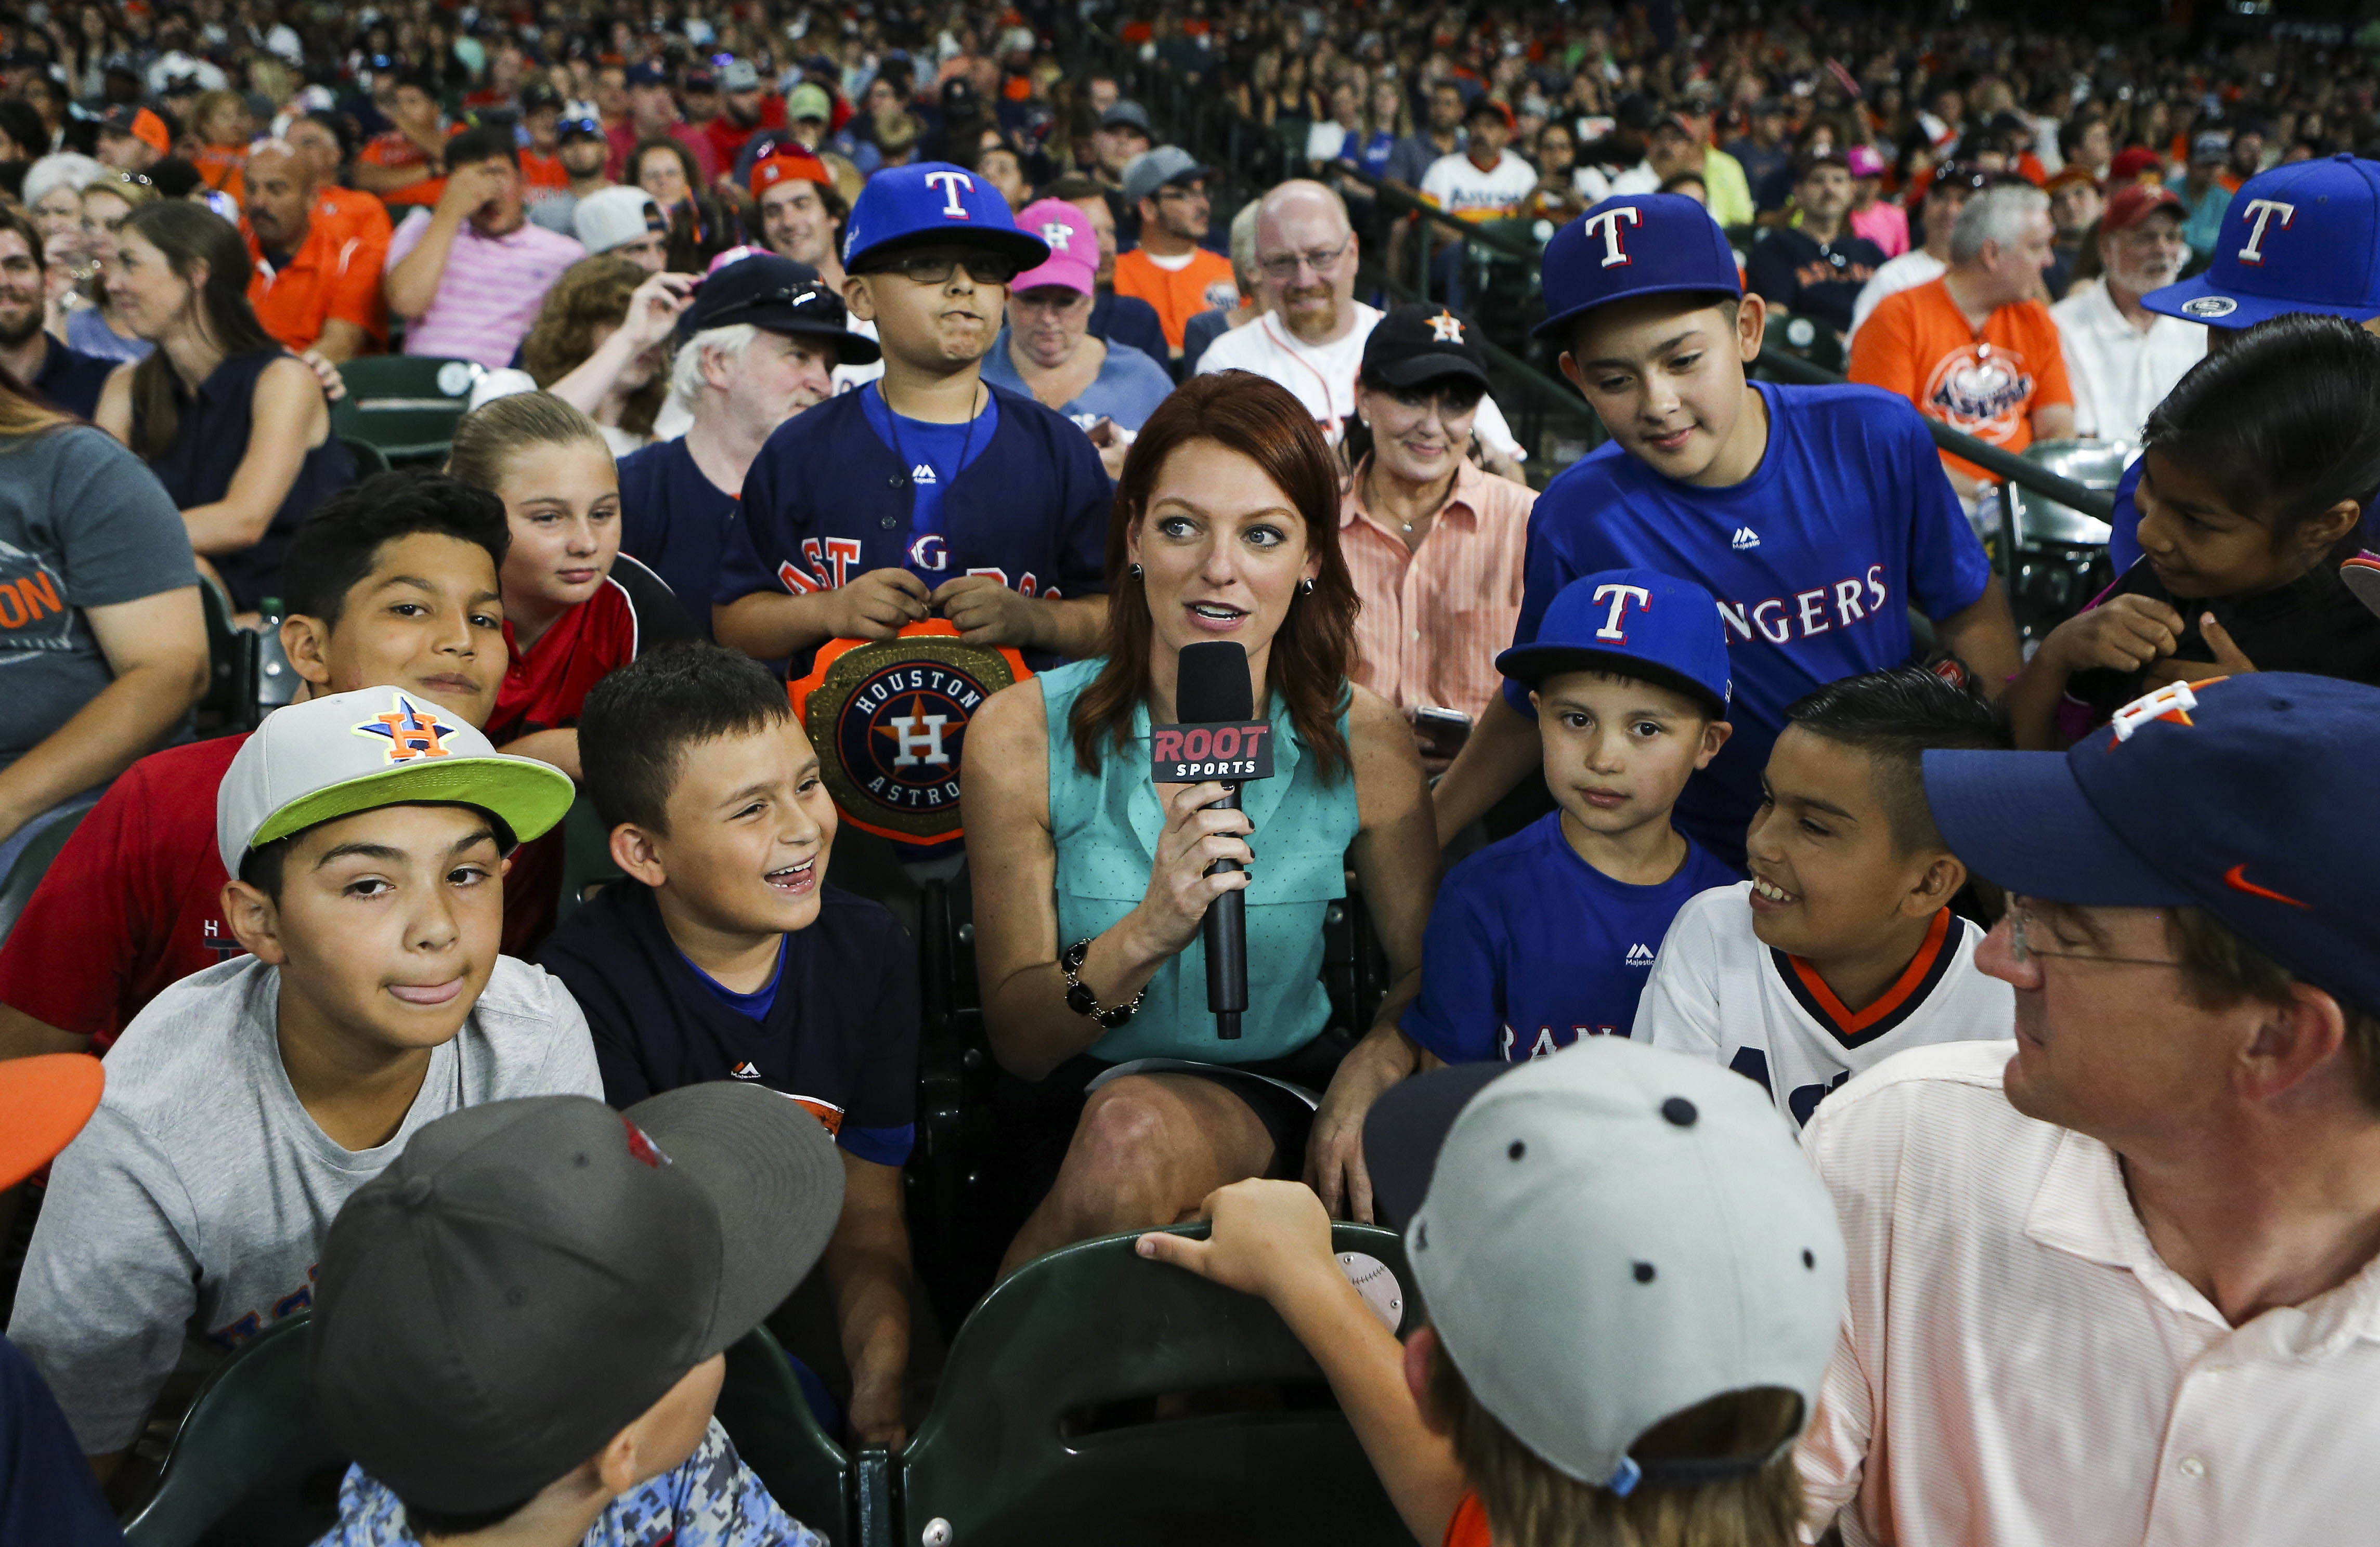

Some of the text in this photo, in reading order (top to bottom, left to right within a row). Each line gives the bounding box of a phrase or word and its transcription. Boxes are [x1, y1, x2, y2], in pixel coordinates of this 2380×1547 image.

[925, 171, 976, 220] T
[1585, 206, 1643, 270] T
[2238, 199, 2298, 267] T
[1432, 316, 1465, 345] H
[0, 570, 63, 628] ON
[1592, 583, 1654, 645] T
[1715, 563, 1888, 646] NGERS
[855, 669, 981, 715] HOUSTON
[378, 712, 449, 759] H
[890, 714, 950, 766] H
[1154, 725, 1269, 763] ROOT
[1176, 760, 1256, 777] SPORTS
[1625, 959, 1656, 967] Majestic
